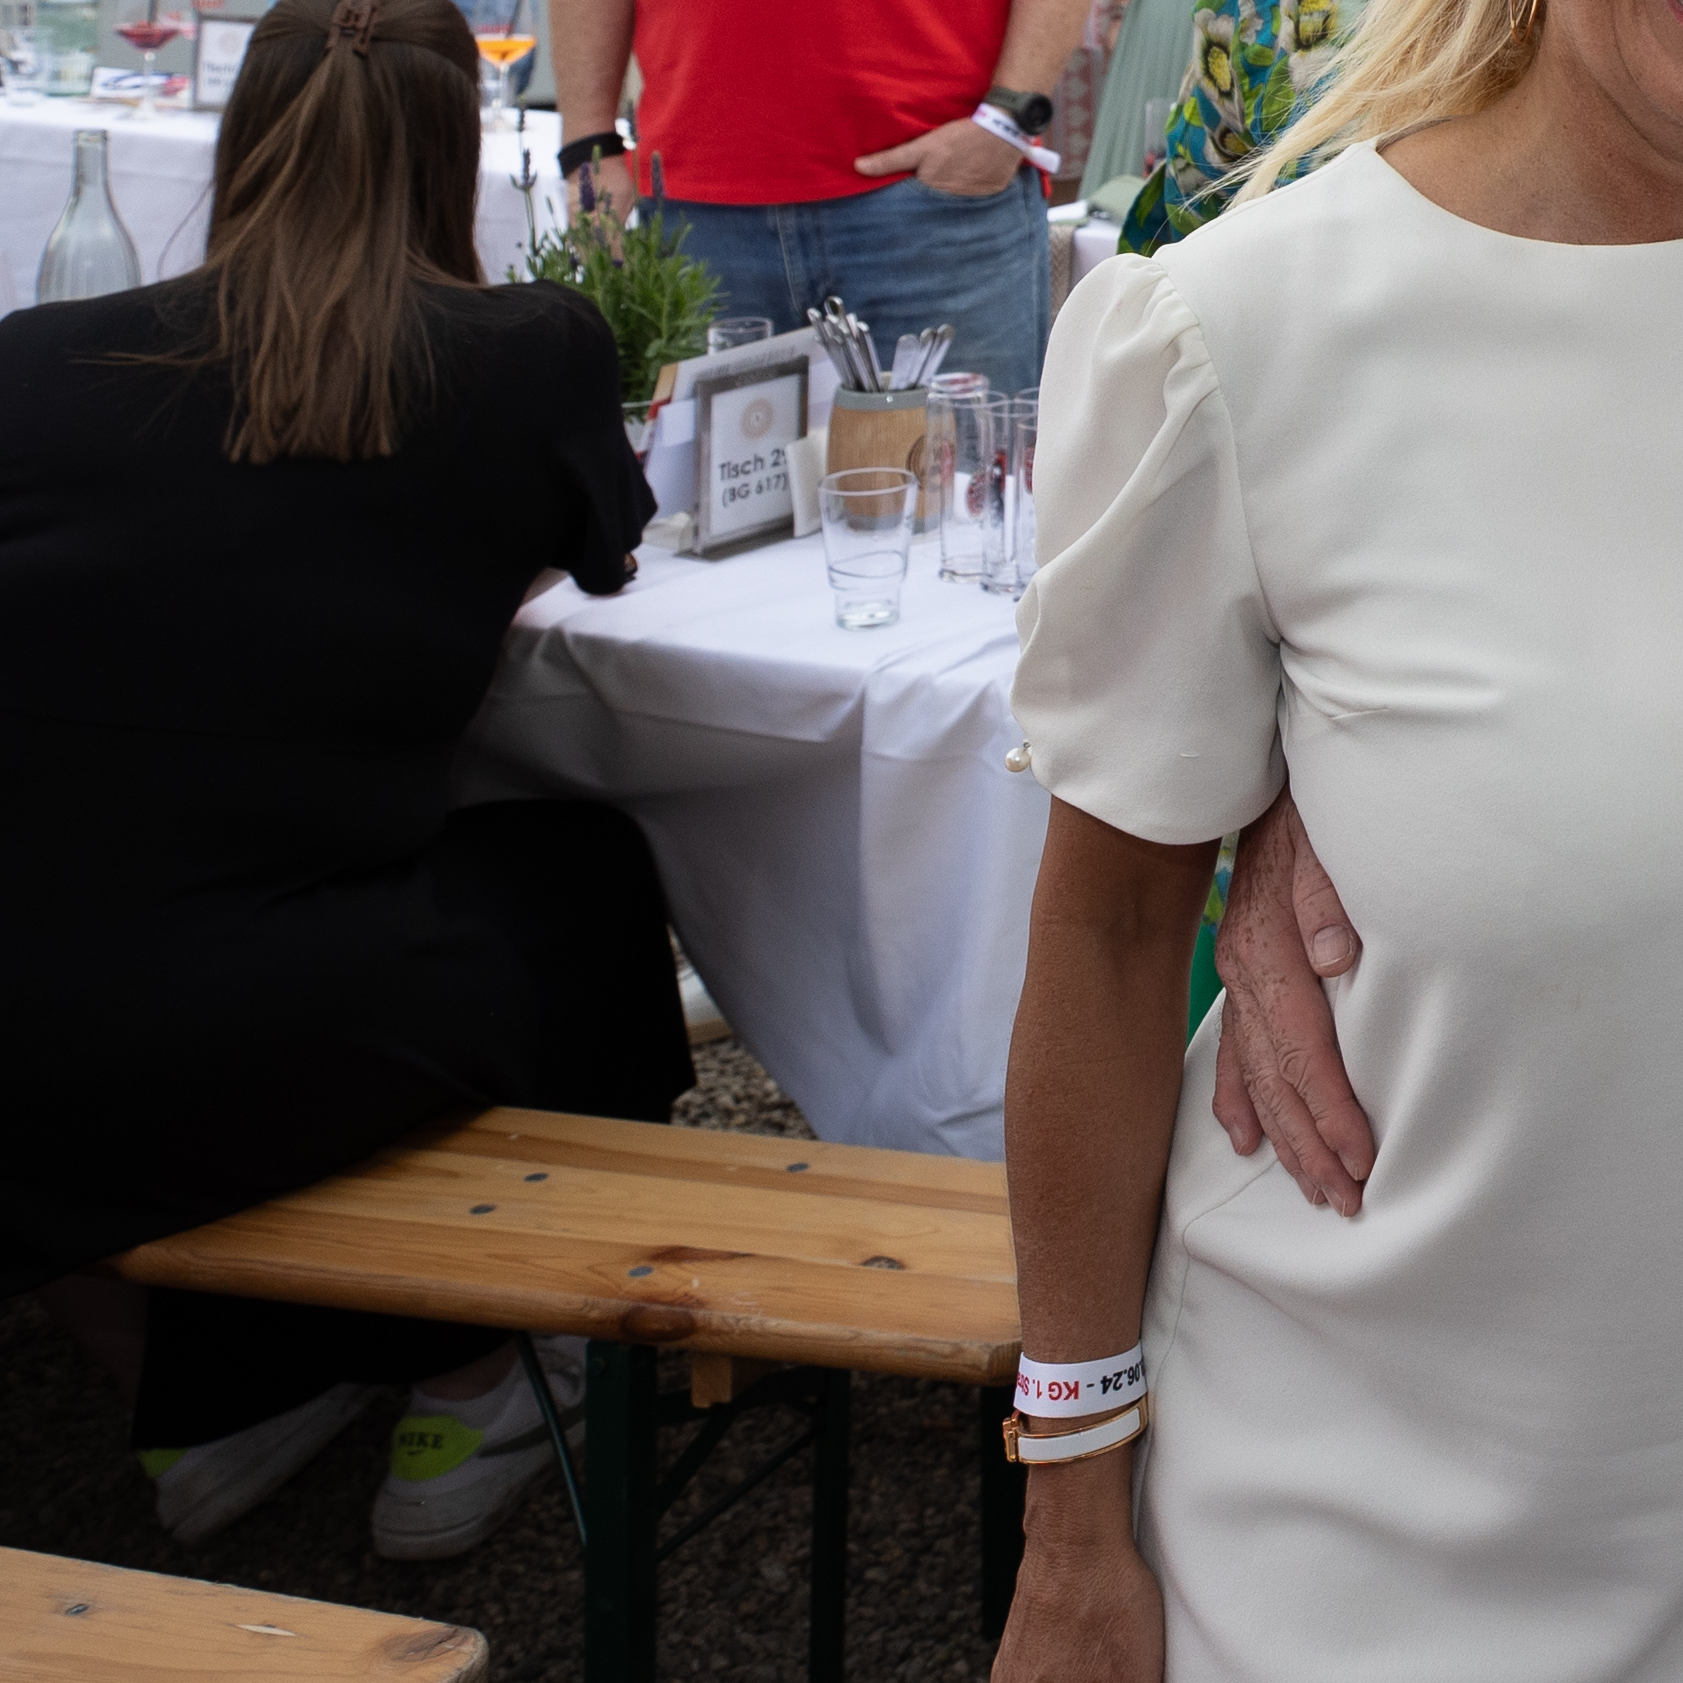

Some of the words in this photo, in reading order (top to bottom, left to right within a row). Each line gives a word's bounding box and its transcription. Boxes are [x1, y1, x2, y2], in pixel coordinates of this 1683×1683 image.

[718, 453, 764, 481] Tisch
[722, 483, 750, 508] (BG
[755, 472, 788, 495] 617)
[1032, 1379, 1042, 1400] 1.
[1048, 1380, 1079, 1401] KG
